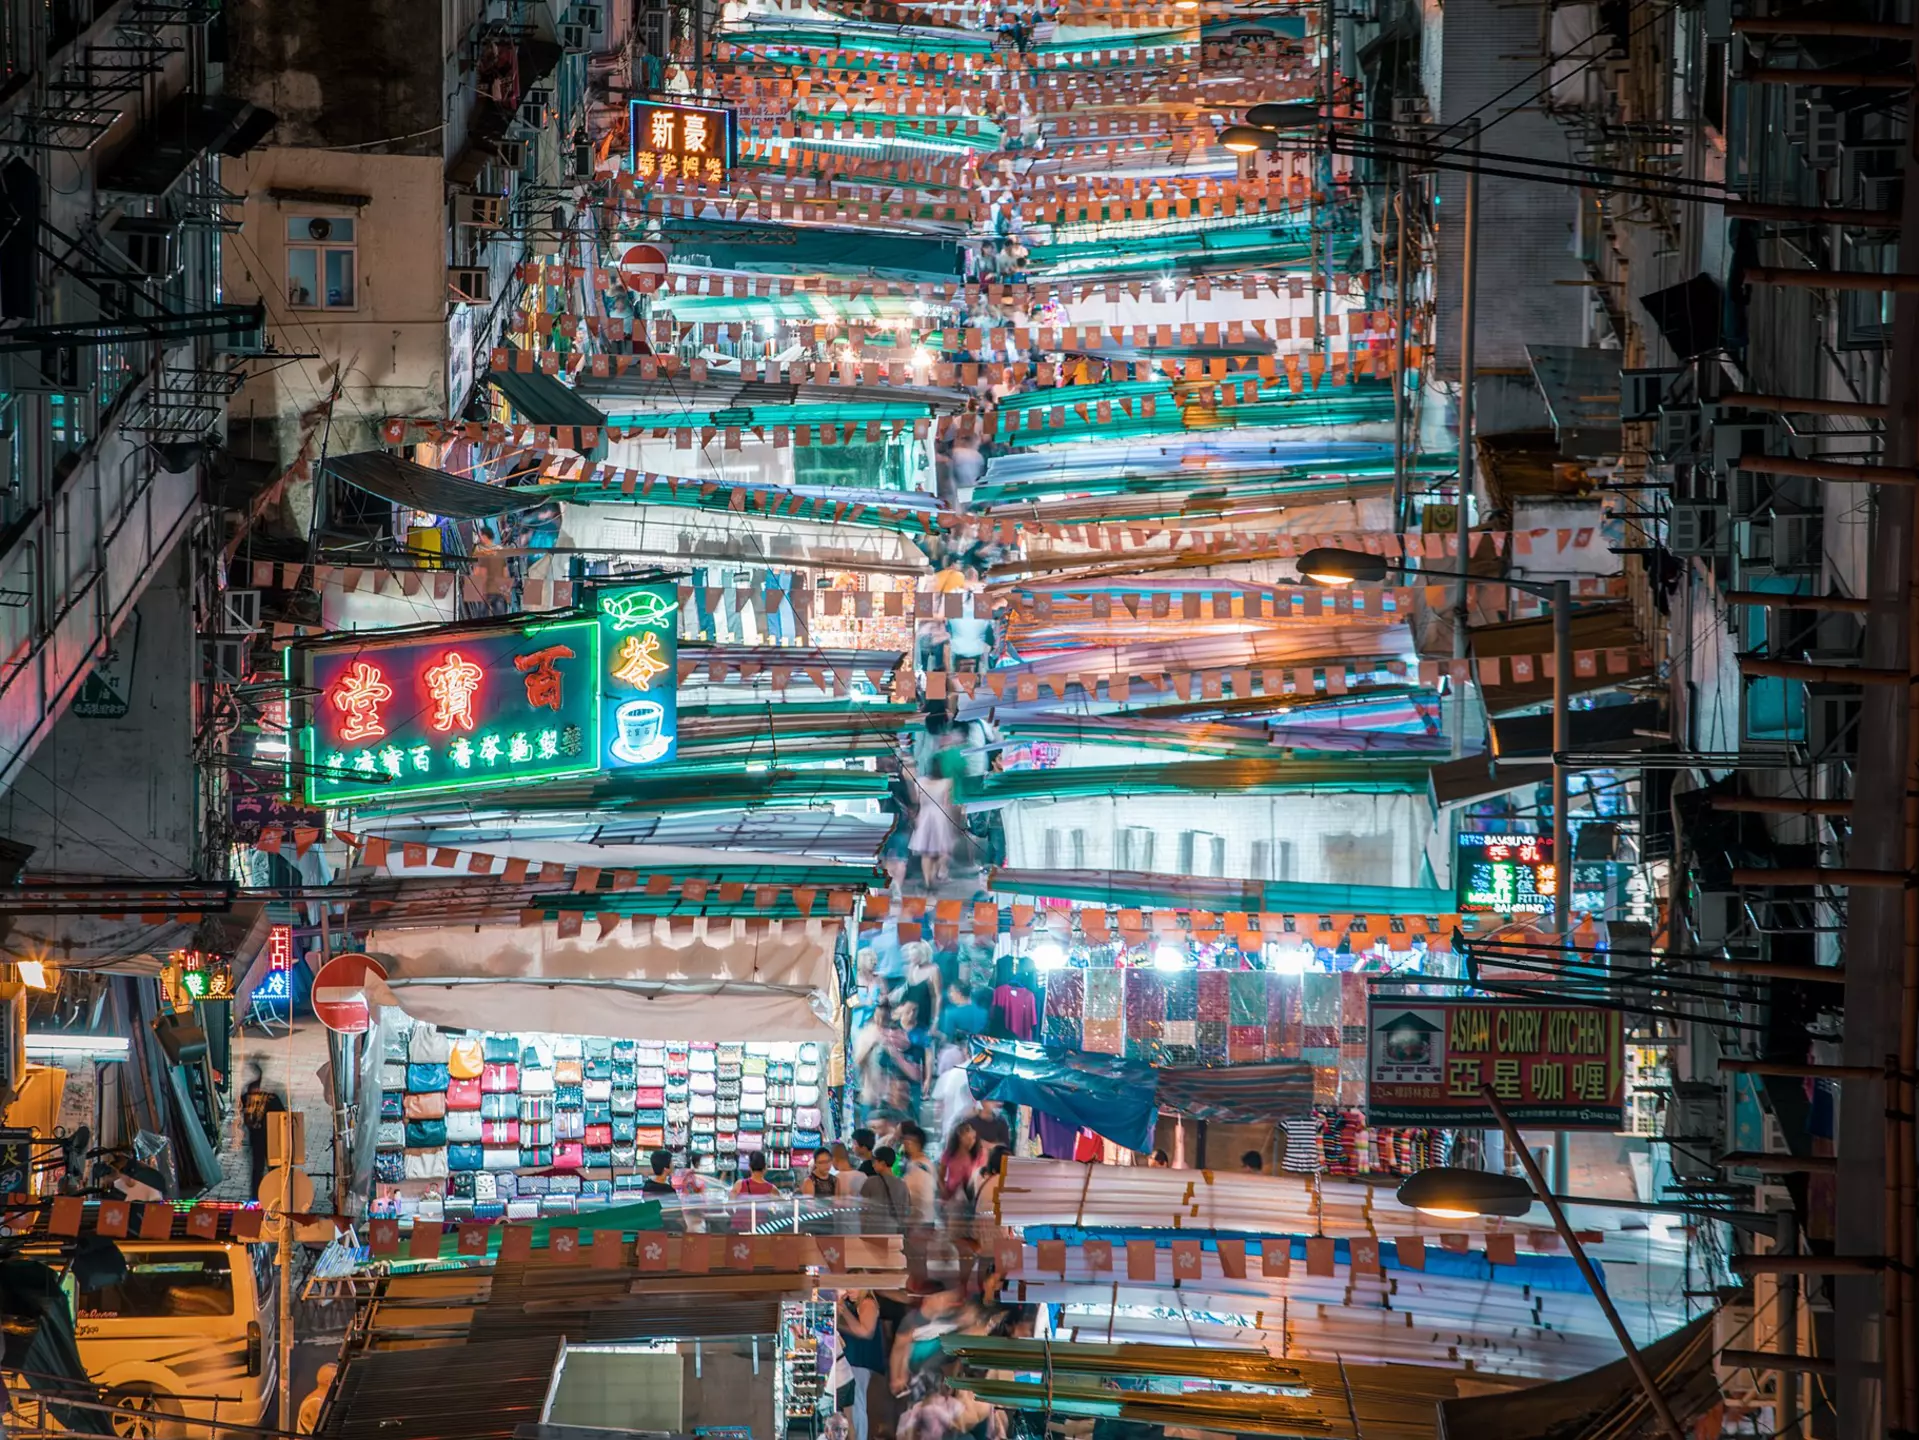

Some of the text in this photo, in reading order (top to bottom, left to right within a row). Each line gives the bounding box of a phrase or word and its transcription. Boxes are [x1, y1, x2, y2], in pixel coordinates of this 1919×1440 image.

[652, 111, 707, 152] 新豪
[1484, 835, 1536, 846] SAMSUNG
[1450, 1009, 1606, 1054] ASIAN CURRY KITCHEN
[1448, 1058, 1606, 1101] 亞星咖喱
